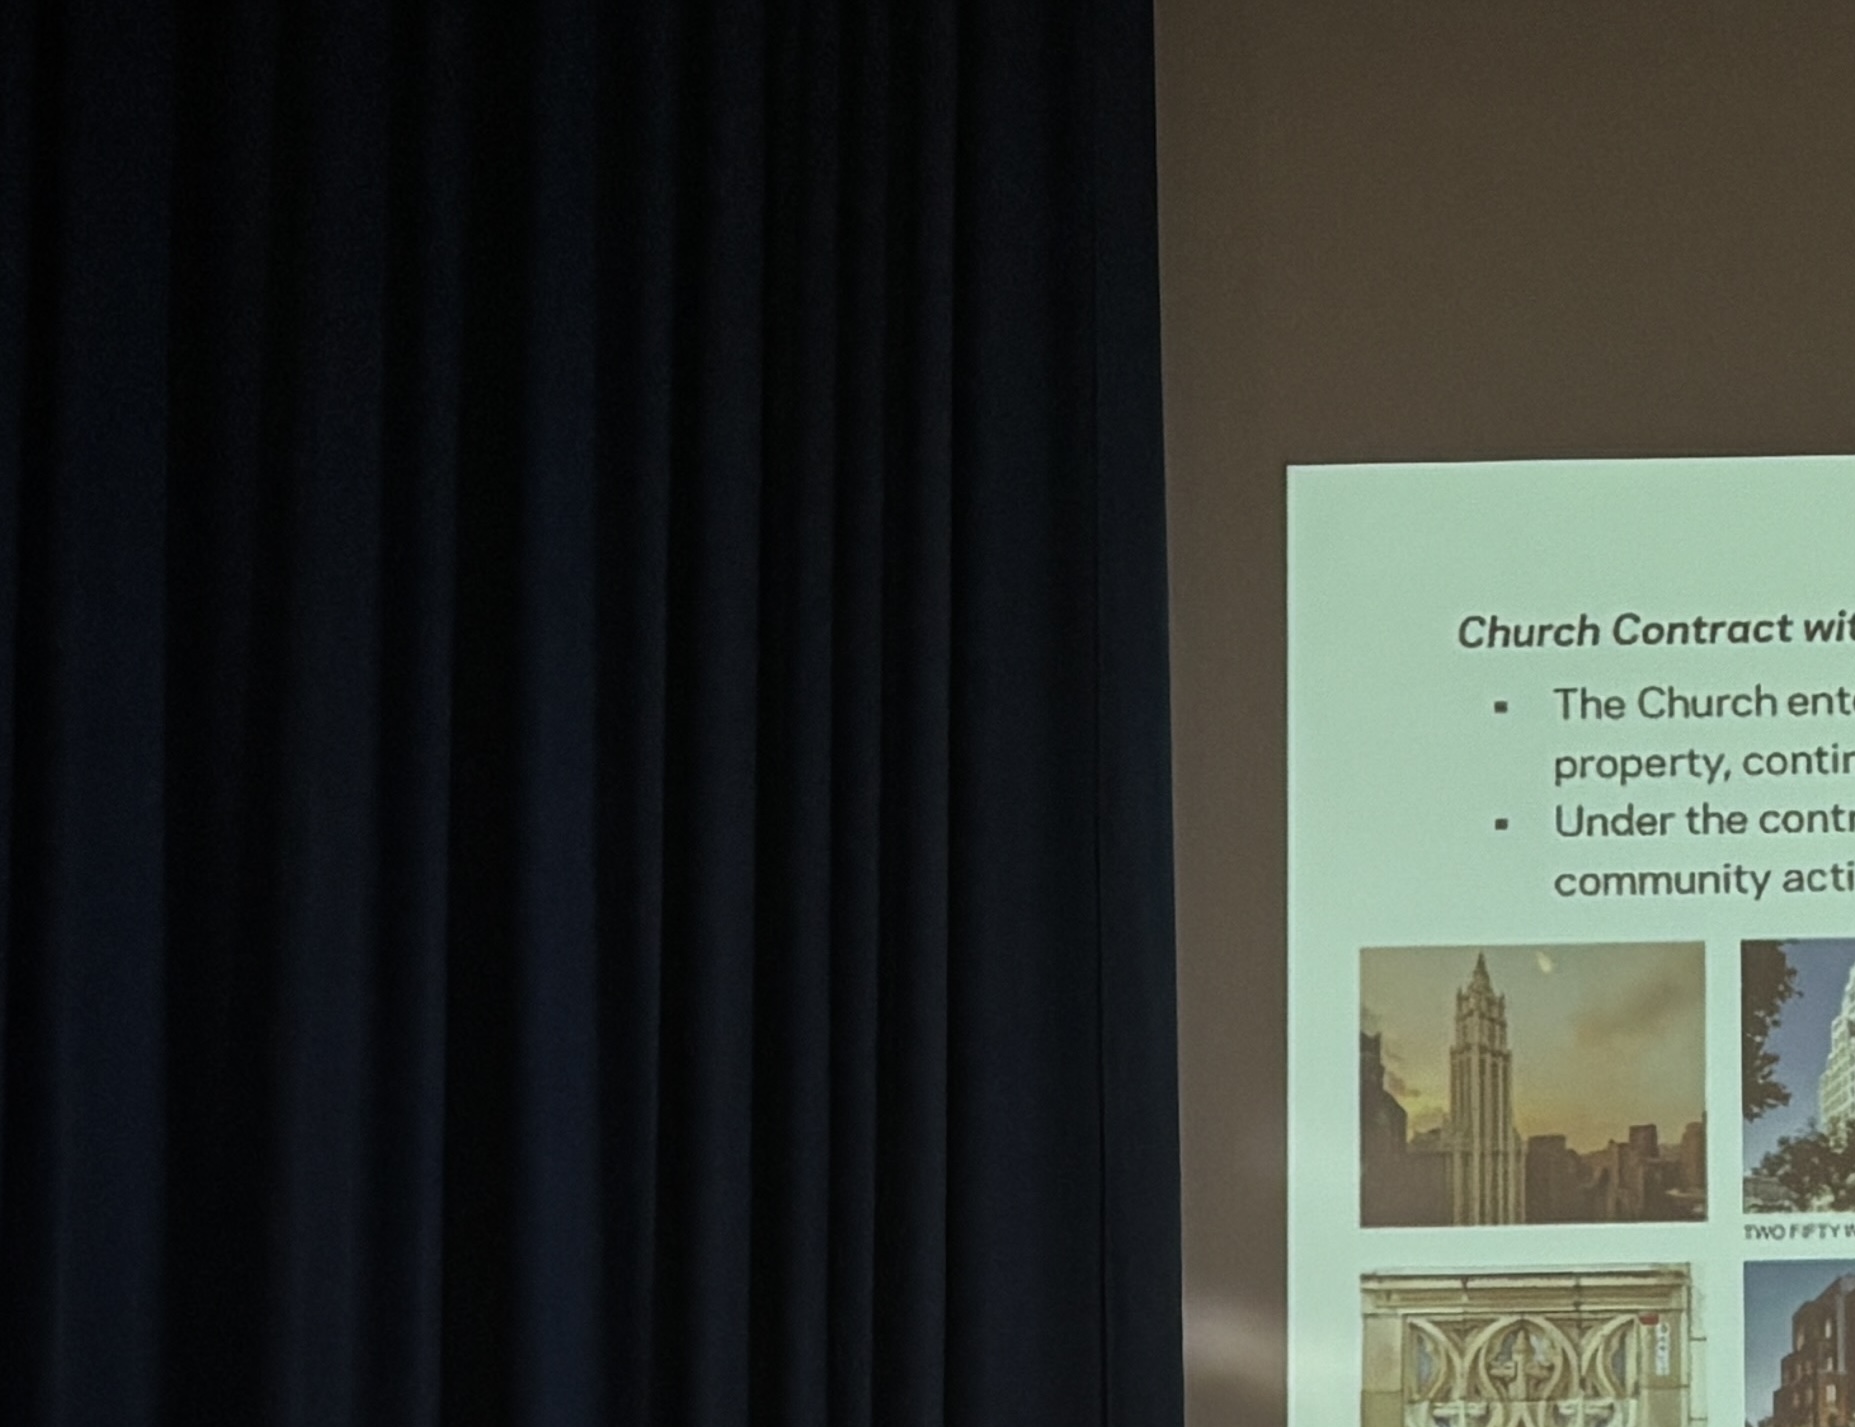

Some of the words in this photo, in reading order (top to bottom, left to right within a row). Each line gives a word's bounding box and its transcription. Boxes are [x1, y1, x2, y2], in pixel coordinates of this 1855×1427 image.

[1458, 612, 1601, 649] Church
[1612, 612, 1795, 646] Contract
[1552, 686, 1627, 721] The
[1637, 683, 1778, 720] Church
[1554, 748, 1732, 785] property,
[1555, 802, 1676, 838] Under
[1684, 801, 1749, 836] the
[1553, 862, 1772, 898] community
[1743, 1223, 1786, 1241] TWO
